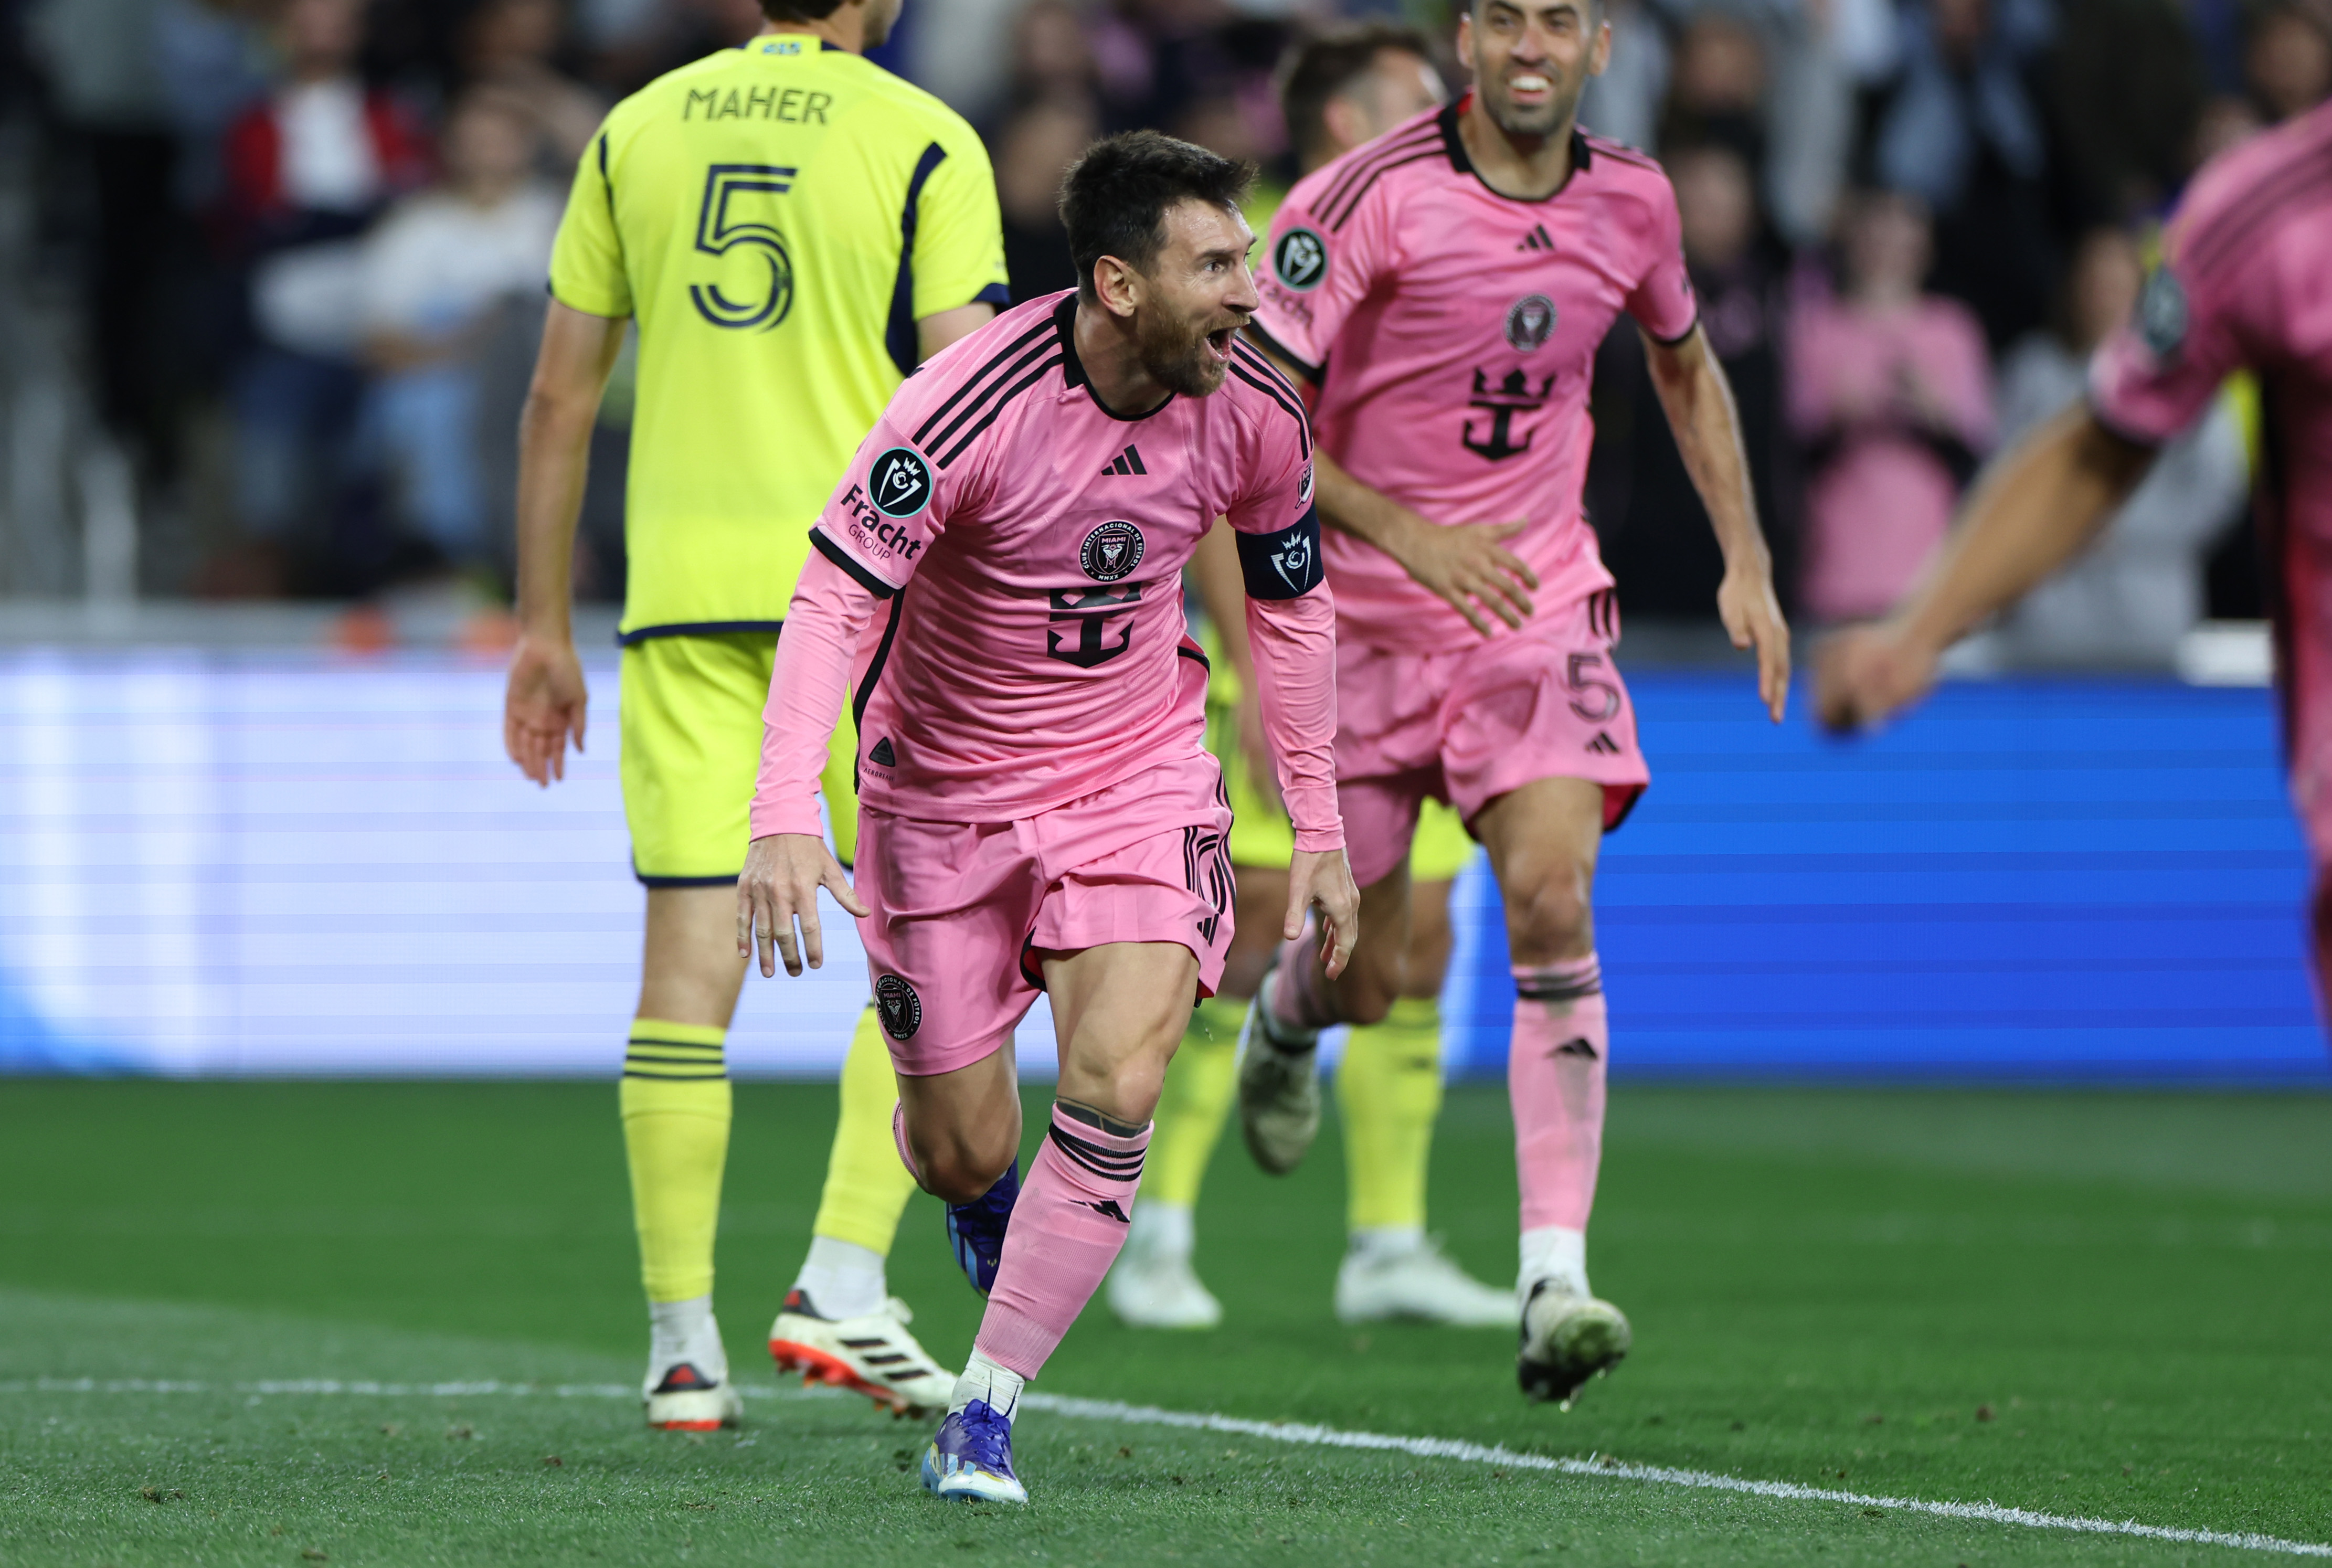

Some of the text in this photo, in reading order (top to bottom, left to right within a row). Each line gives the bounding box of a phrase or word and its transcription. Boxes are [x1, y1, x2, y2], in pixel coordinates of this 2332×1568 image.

[683, 84, 833, 125] MAHER
[689, 164, 798, 334] 5
[841, 483, 921, 560] Fracht
[848, 524, 891, 560] GROUP
[1084, 523, 1135, 549] INTERNACIONAL
[1134, 533, 1141, 541] DE
[1568, 652, 1621, 724] 5
[906, 987, 914, 997] DE
